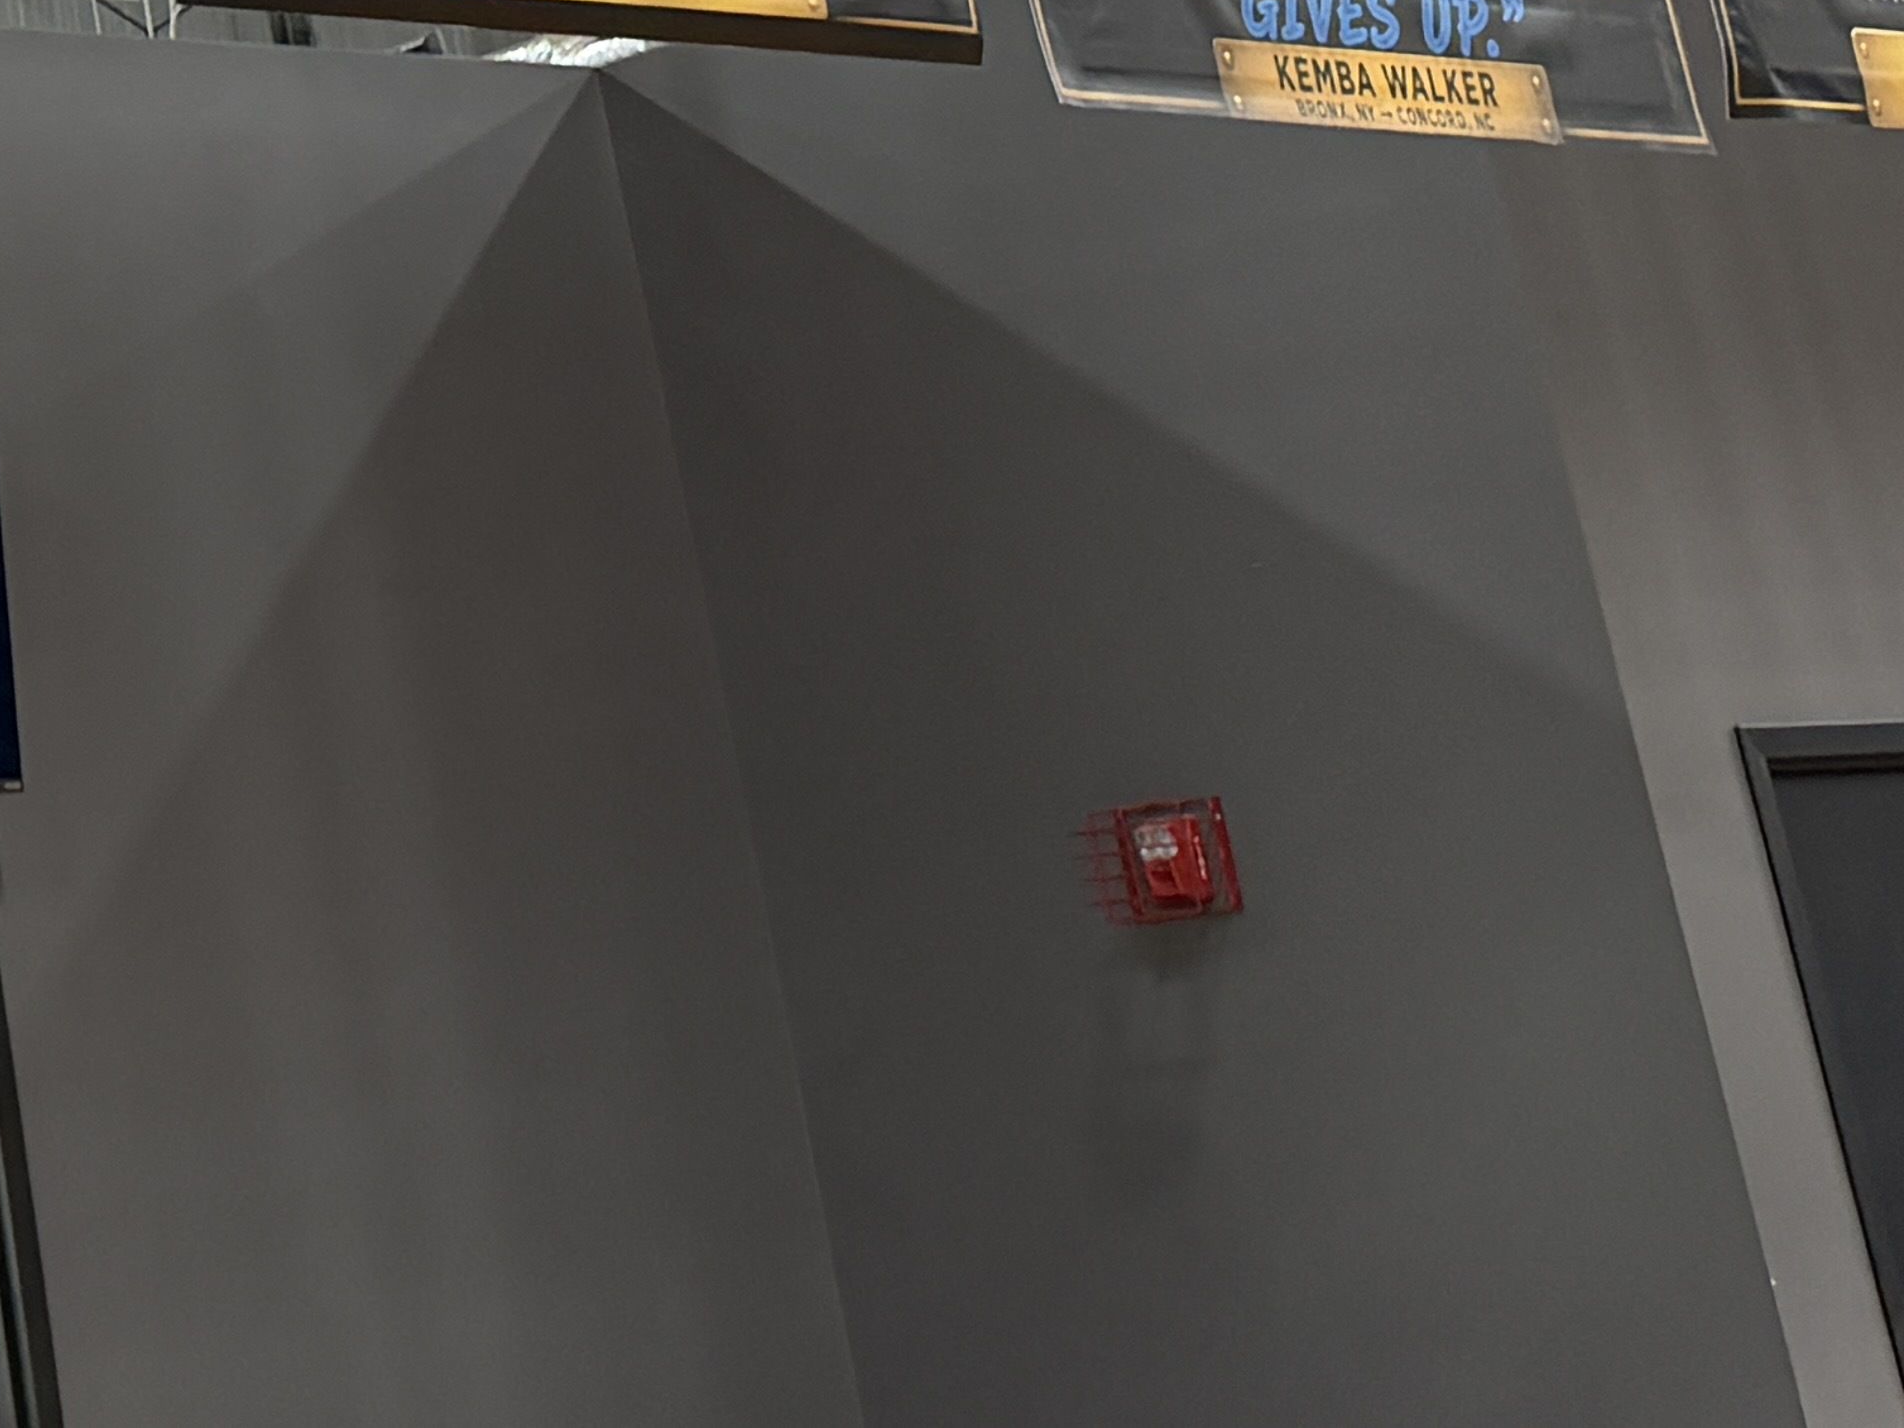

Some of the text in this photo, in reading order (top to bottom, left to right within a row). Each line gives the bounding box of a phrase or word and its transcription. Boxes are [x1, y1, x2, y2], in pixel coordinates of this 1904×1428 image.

[1274, 54, 1499, 109] KEMBA WALKER
[1356, 102, 1376, 123] NY
[1474, 112, 1496, 131] NC
